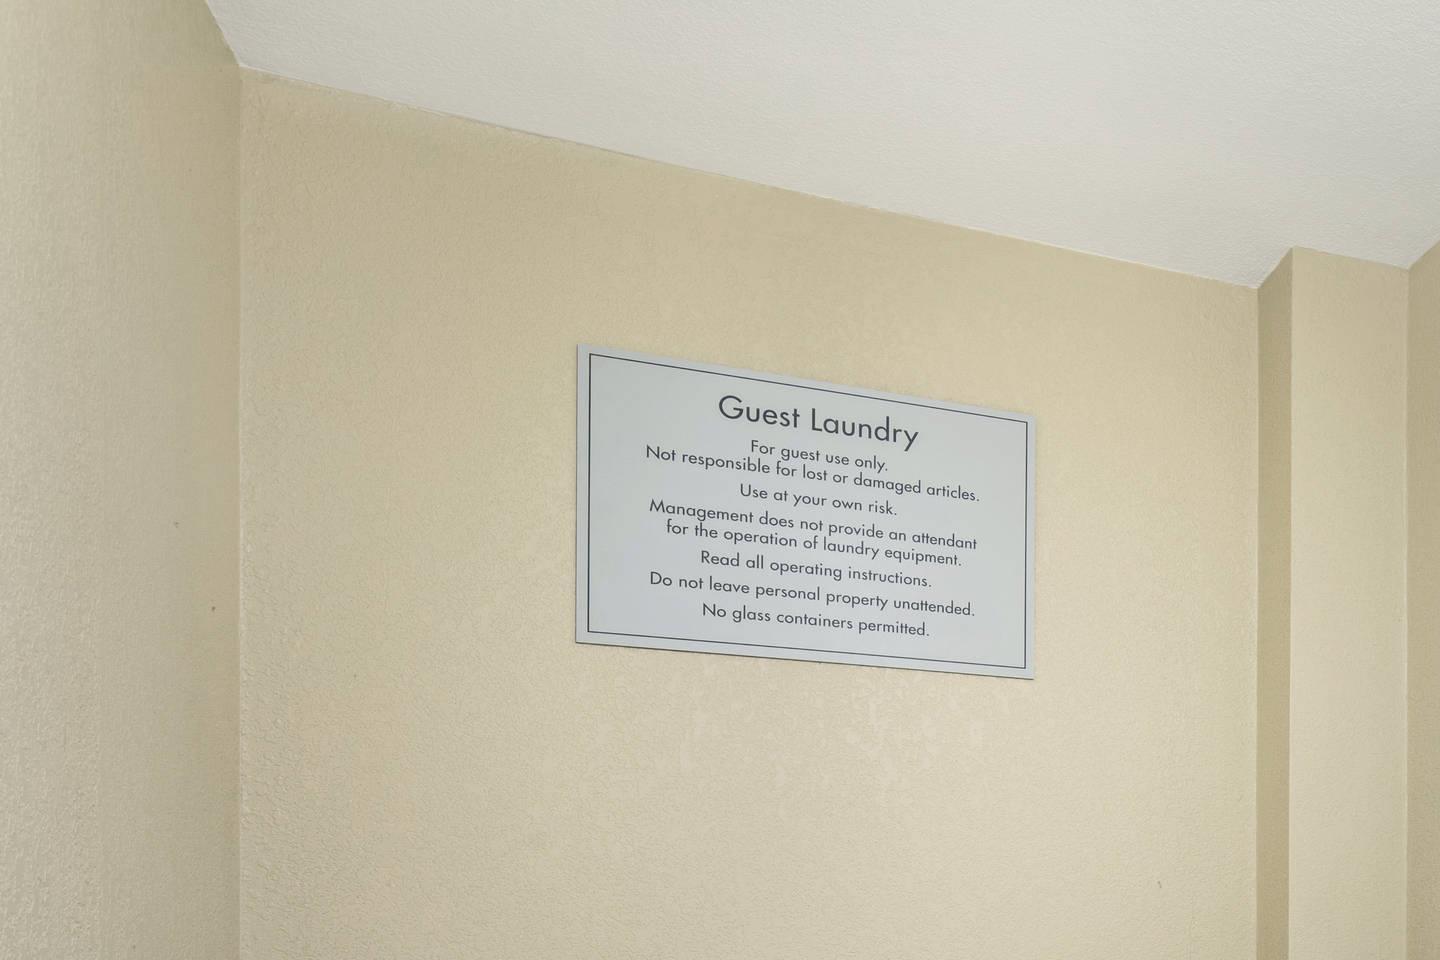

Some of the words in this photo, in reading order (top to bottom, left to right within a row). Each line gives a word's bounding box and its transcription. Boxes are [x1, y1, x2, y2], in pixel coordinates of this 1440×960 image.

[718, 394, 801, 429] Guest
[811, 407, 919, 452] Laundry
[646, 444, 677, 462] Not
[682, 453, 771, 474] responsible
[775, 460, 798, 477] for
[802, 463, 828, 481] lost
[832, 474, 849, 484] or
[853, 471, 921, 496] damaged
[926, 484, 980, 502] articles.
[751, 439, 776, 456] For
[780, 448, 821, 462] guest
[825, 454, 850, 466] use
[854, 454, 888, 474] only.
[740, 482, 768, 500] Use
[773, 490, 789, 502] at
[792, 494, 828, 507] your
[832, 499, 863, 512] own
[868, 499, 897, 516] risk.
[649, 498, 754, 524] Management
[758, 510, 795, 529] does
[800, 520, 824, 532] not
[828, 523, 884, 539] provide
[888, 531, 907, 542] an
[911, 532, 978, 550] attendant
[666, 518, 689, 535] for
[694, 521, 719, 539] the
[723, 530, 798, 548] operation
[802, 534, 819, 550] of
[823, 535, 880, 561] laundry
[884, 548, 962, 567] equipment.
[701, 549, 740, 567] Read
[745, 553, 764, 570] all
[769, 561, 842, 582] operating
[848, 565, 932, 588] instructions.
[650, 570, 673, 587] Do
[678, 577, 704, 590] not
[709, 575, 750, 594] leave
[755, 586, 820, 601] personal
[826, 593, 889, 612] property
[893, 599, 975, 617] unattended.
[702, 602, 727, 618] No
[731, 604, 771, 624] glass
[776, 613, 854, 630] containers
[858, 620, 930, 637] permitted.
